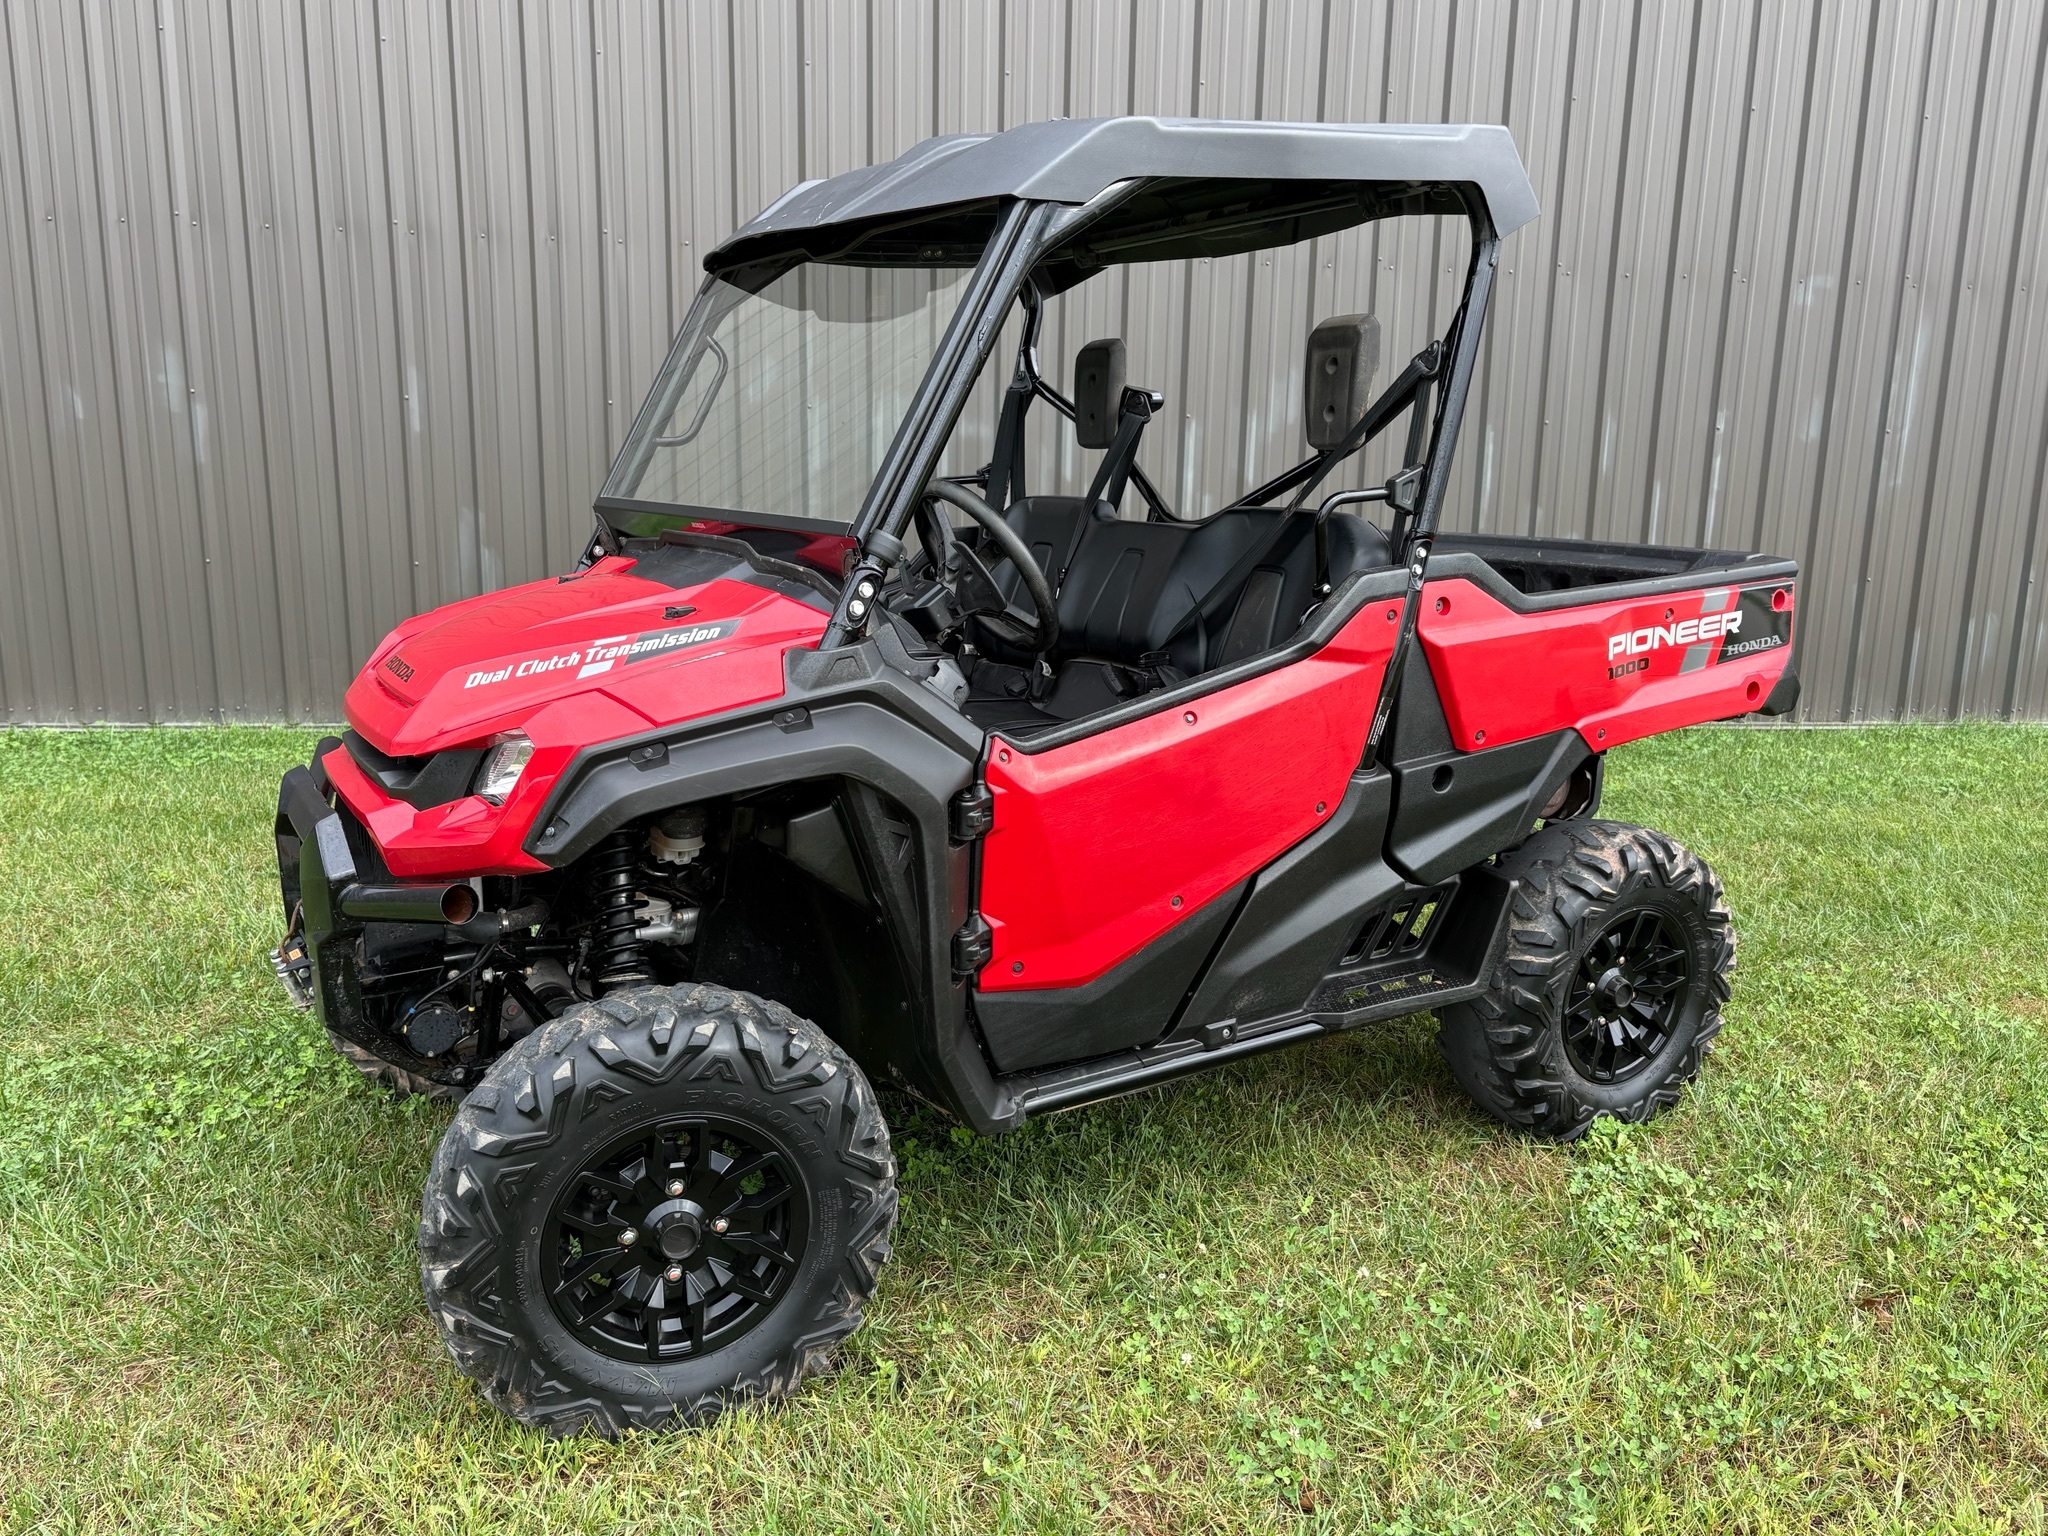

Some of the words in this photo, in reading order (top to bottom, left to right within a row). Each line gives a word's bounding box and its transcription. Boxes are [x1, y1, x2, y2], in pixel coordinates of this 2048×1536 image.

[464, 663, 514, 690] Dual
[515, 651, 581, 678] Clutch
[585, 626, 722, 664] Transmission
[1608, 610, 1743, 661] PIONEER
[1726, 634, 1783, 656] HONDA
[385, 655, 416, 683] HONDA
[1607, 658, 1650, 681] 1000
[685, 1089, 824, 1160] BIGHORN
[537, 1334, 680, 1398] MAXXIS
